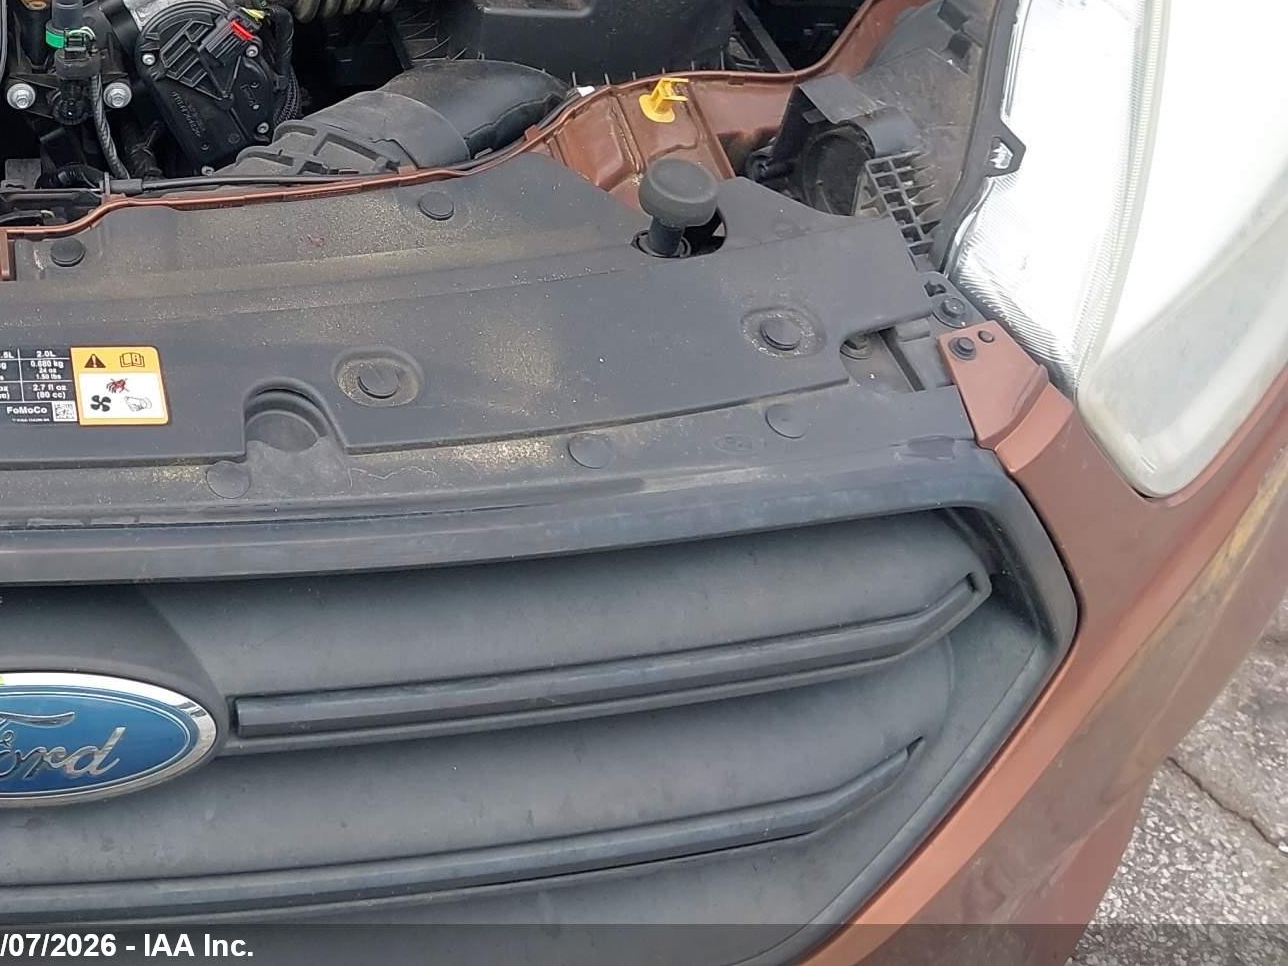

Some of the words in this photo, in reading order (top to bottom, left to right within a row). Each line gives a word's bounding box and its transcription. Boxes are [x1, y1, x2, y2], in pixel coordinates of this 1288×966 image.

[36, 350, 57, 358] 2.0L
[53, 360, 64, 369] kg
[51, 391, 66, 399] cc)
[6, 406, 48, 415] FoMoCo
